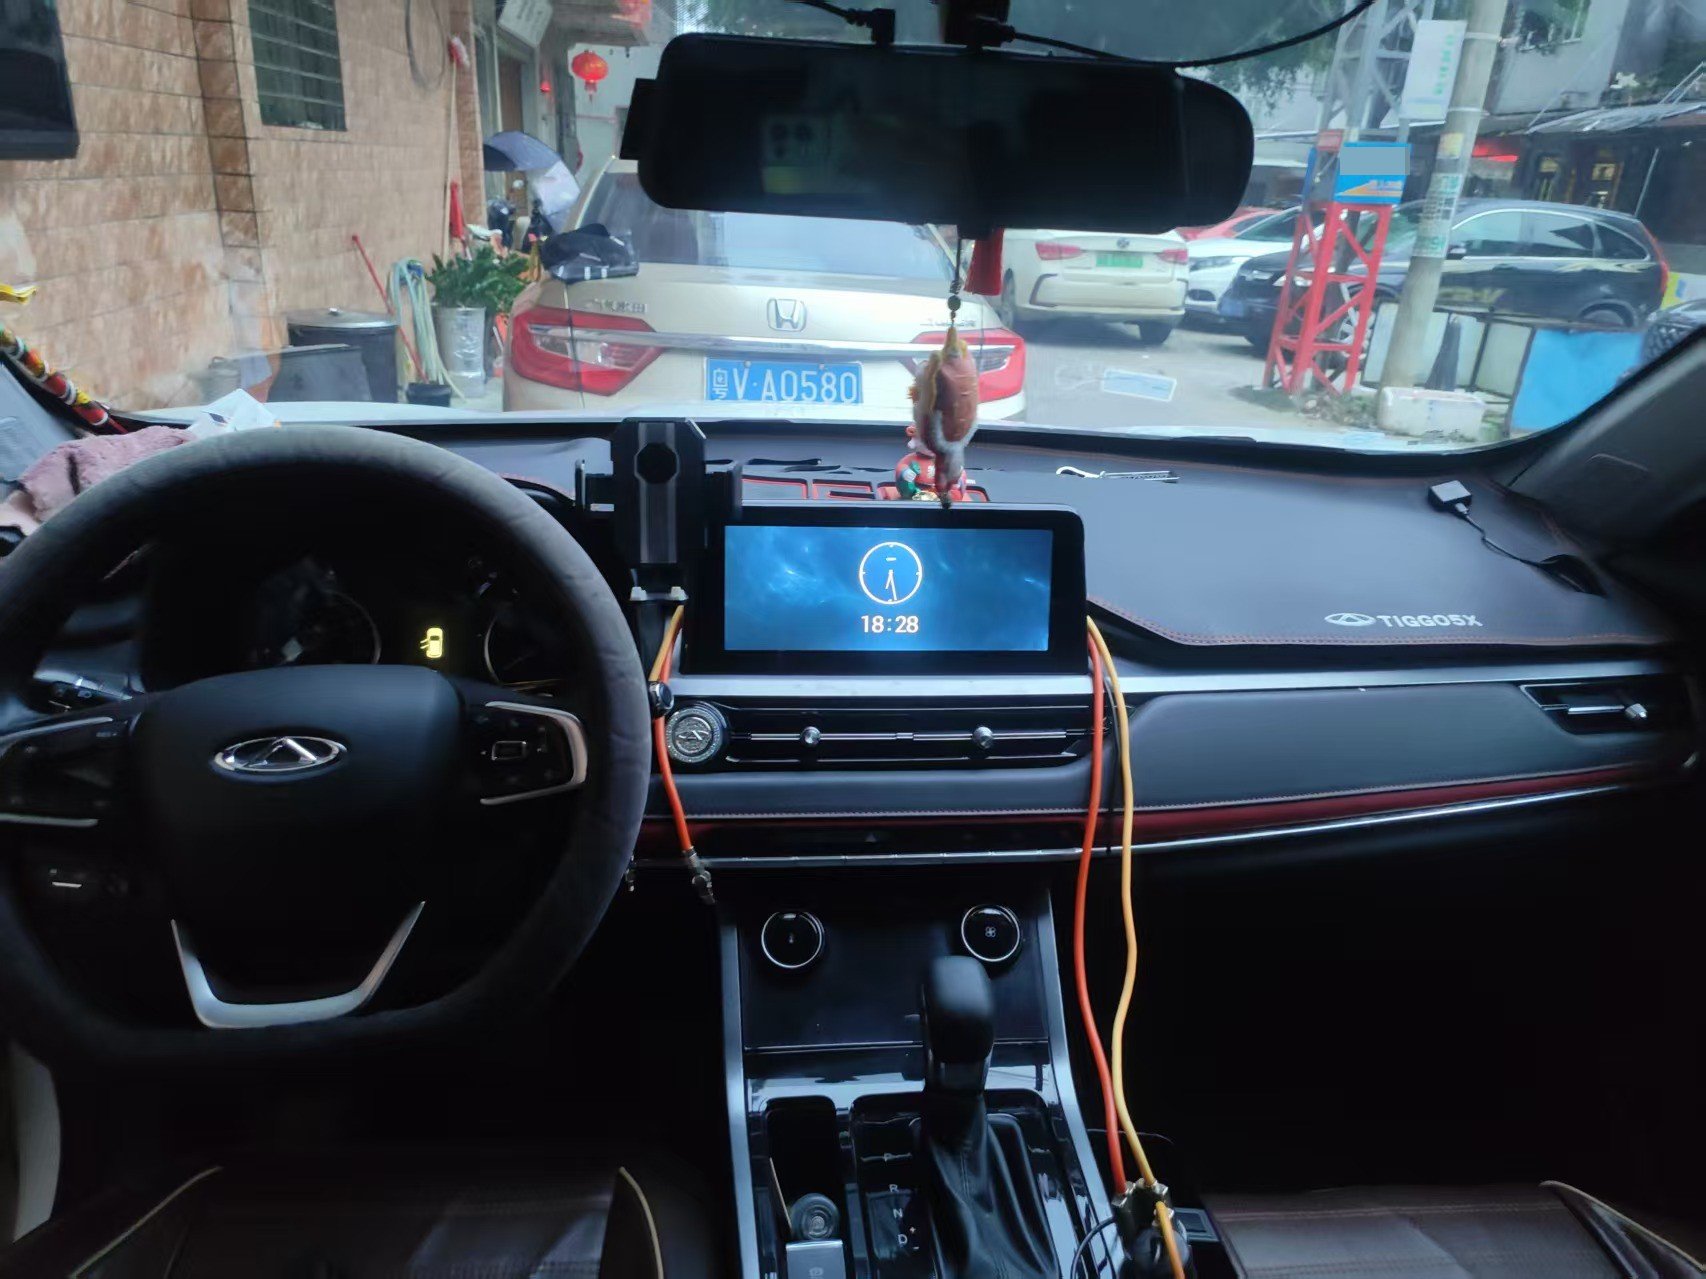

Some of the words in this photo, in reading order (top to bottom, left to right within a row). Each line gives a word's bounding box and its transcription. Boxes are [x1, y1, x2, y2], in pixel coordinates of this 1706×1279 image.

[861, 615, 919, 633] 18:28
[1376, 614, 1483, 627] TIGGO5X
[883, 1152, 893, 1162] P
[889, 1183, 899, 1193] R
[893, 1208, 904, 1219] N
[897, 1233, 908, 1246] D
